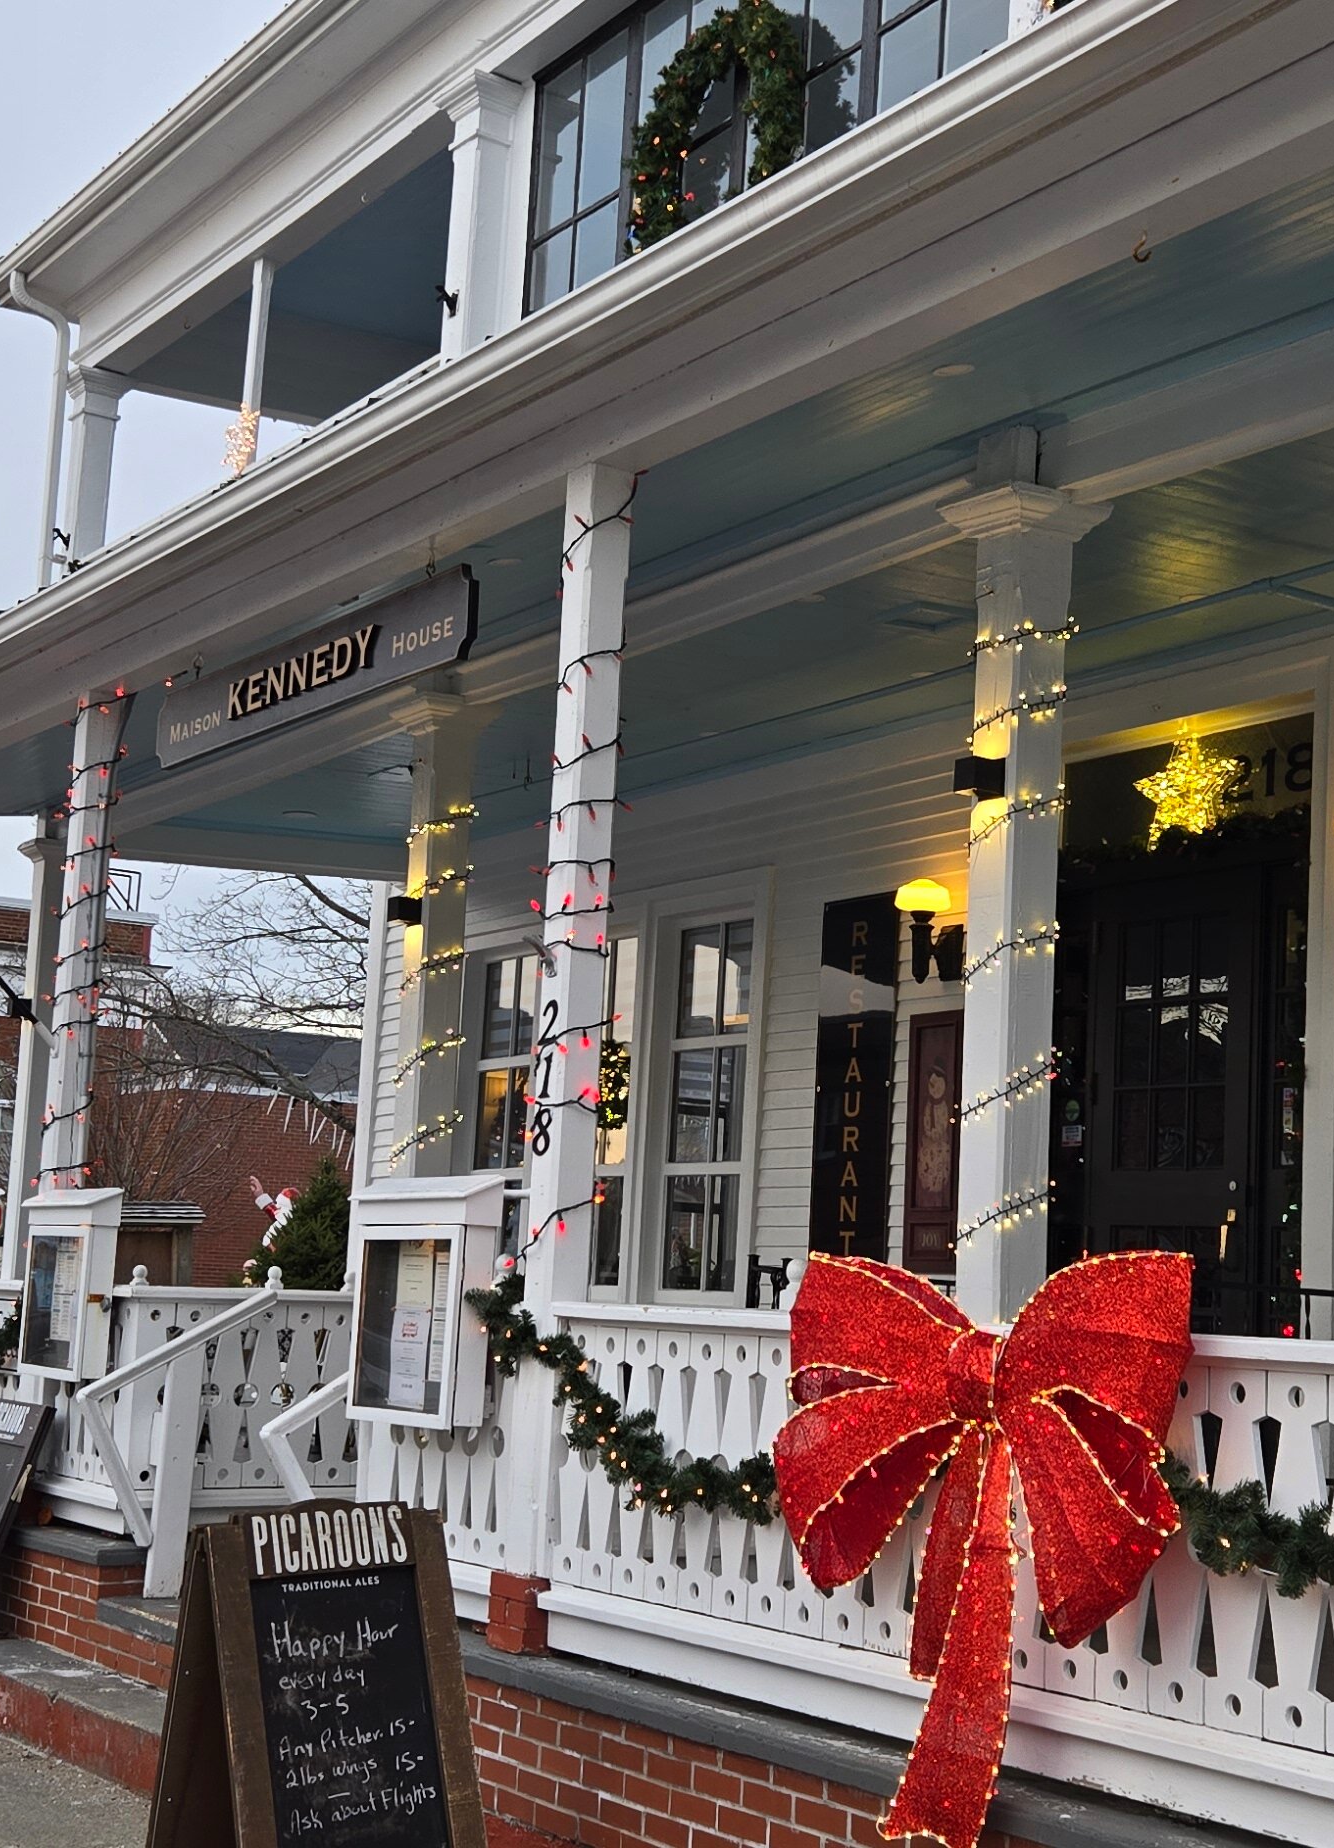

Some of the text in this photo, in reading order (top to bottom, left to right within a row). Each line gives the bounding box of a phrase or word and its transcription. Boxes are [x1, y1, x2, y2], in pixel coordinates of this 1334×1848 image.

[227, 623, 378, 721] KENNEDY
[1221, 742, 1313, 802] 218
[531, 999, 559, 1157] 218
[838, 920, 868, 1257] RESTAURANT
[251, 1504, 409, 1577] PICAROONS
[281, 1575, 381, 1593] TRADITIONAL ALES
[270, 1616, 399, 1664] Happy Hour
[278, 1665, 365, 1690] every day
[278, 1735, 313, 1762] Any
[332, 1757, 378, 1784] wings
[290, 1780, 436, 1836] Ask about Flights
